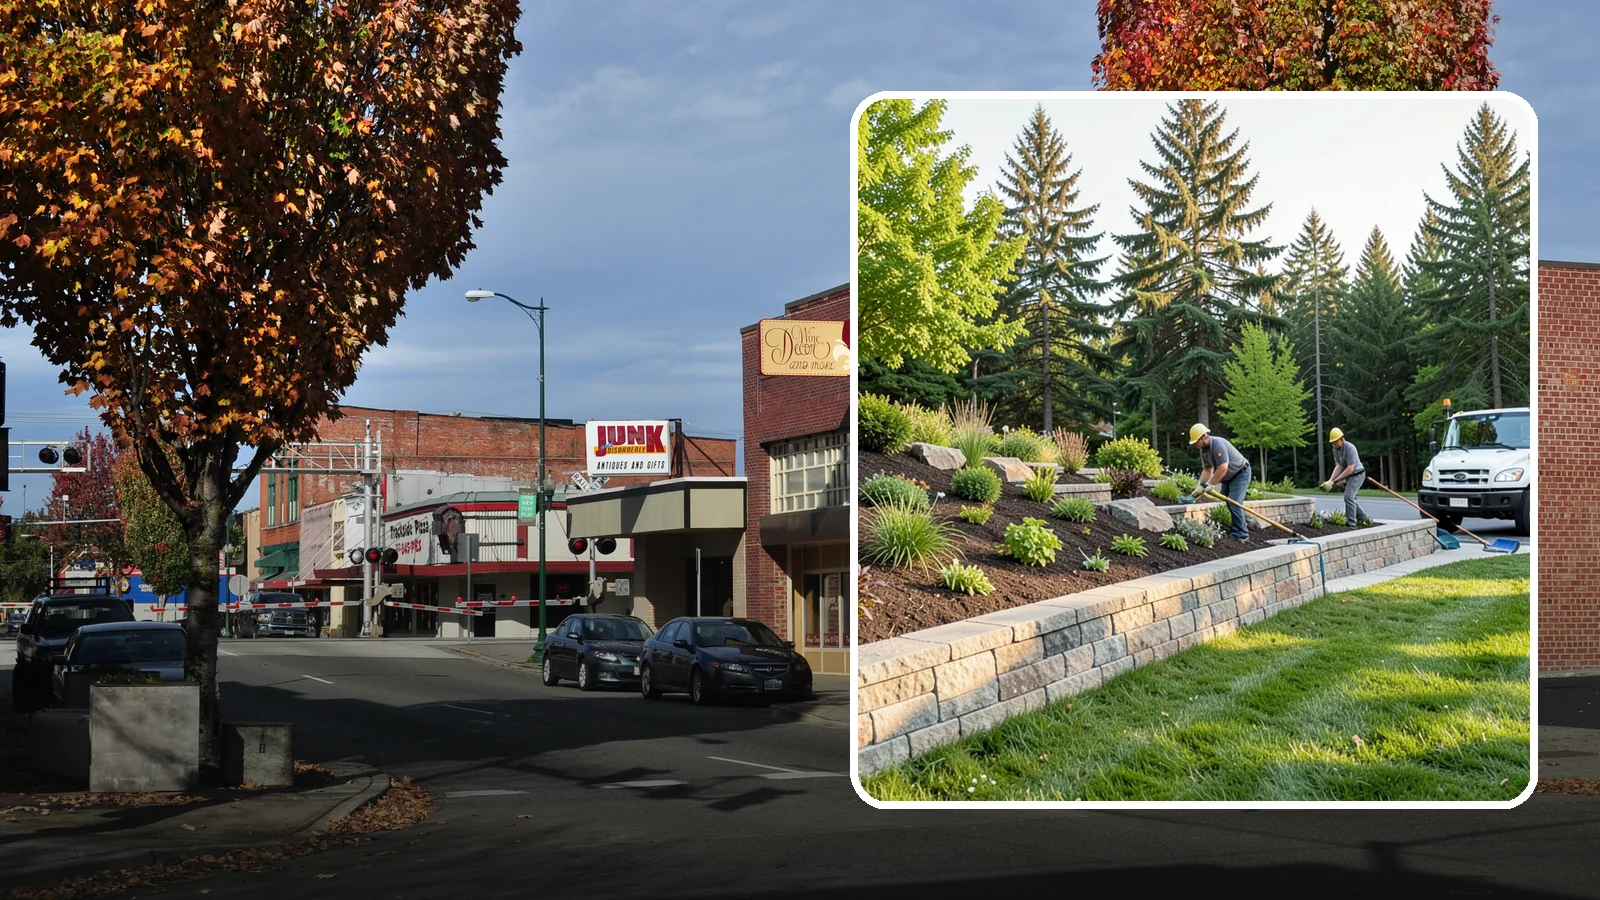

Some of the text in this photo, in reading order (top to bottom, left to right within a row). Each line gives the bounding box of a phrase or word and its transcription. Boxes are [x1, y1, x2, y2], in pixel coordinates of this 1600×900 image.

[765, 328, 831, 365] Decor
[596, 425, 664, 457] JUNK
[607, 446, 646, 454] DISORDERLY
[597, 460, 665, 470] ANTIQUES AND GIFTS
[415, 519, 429, 535] Pizza
